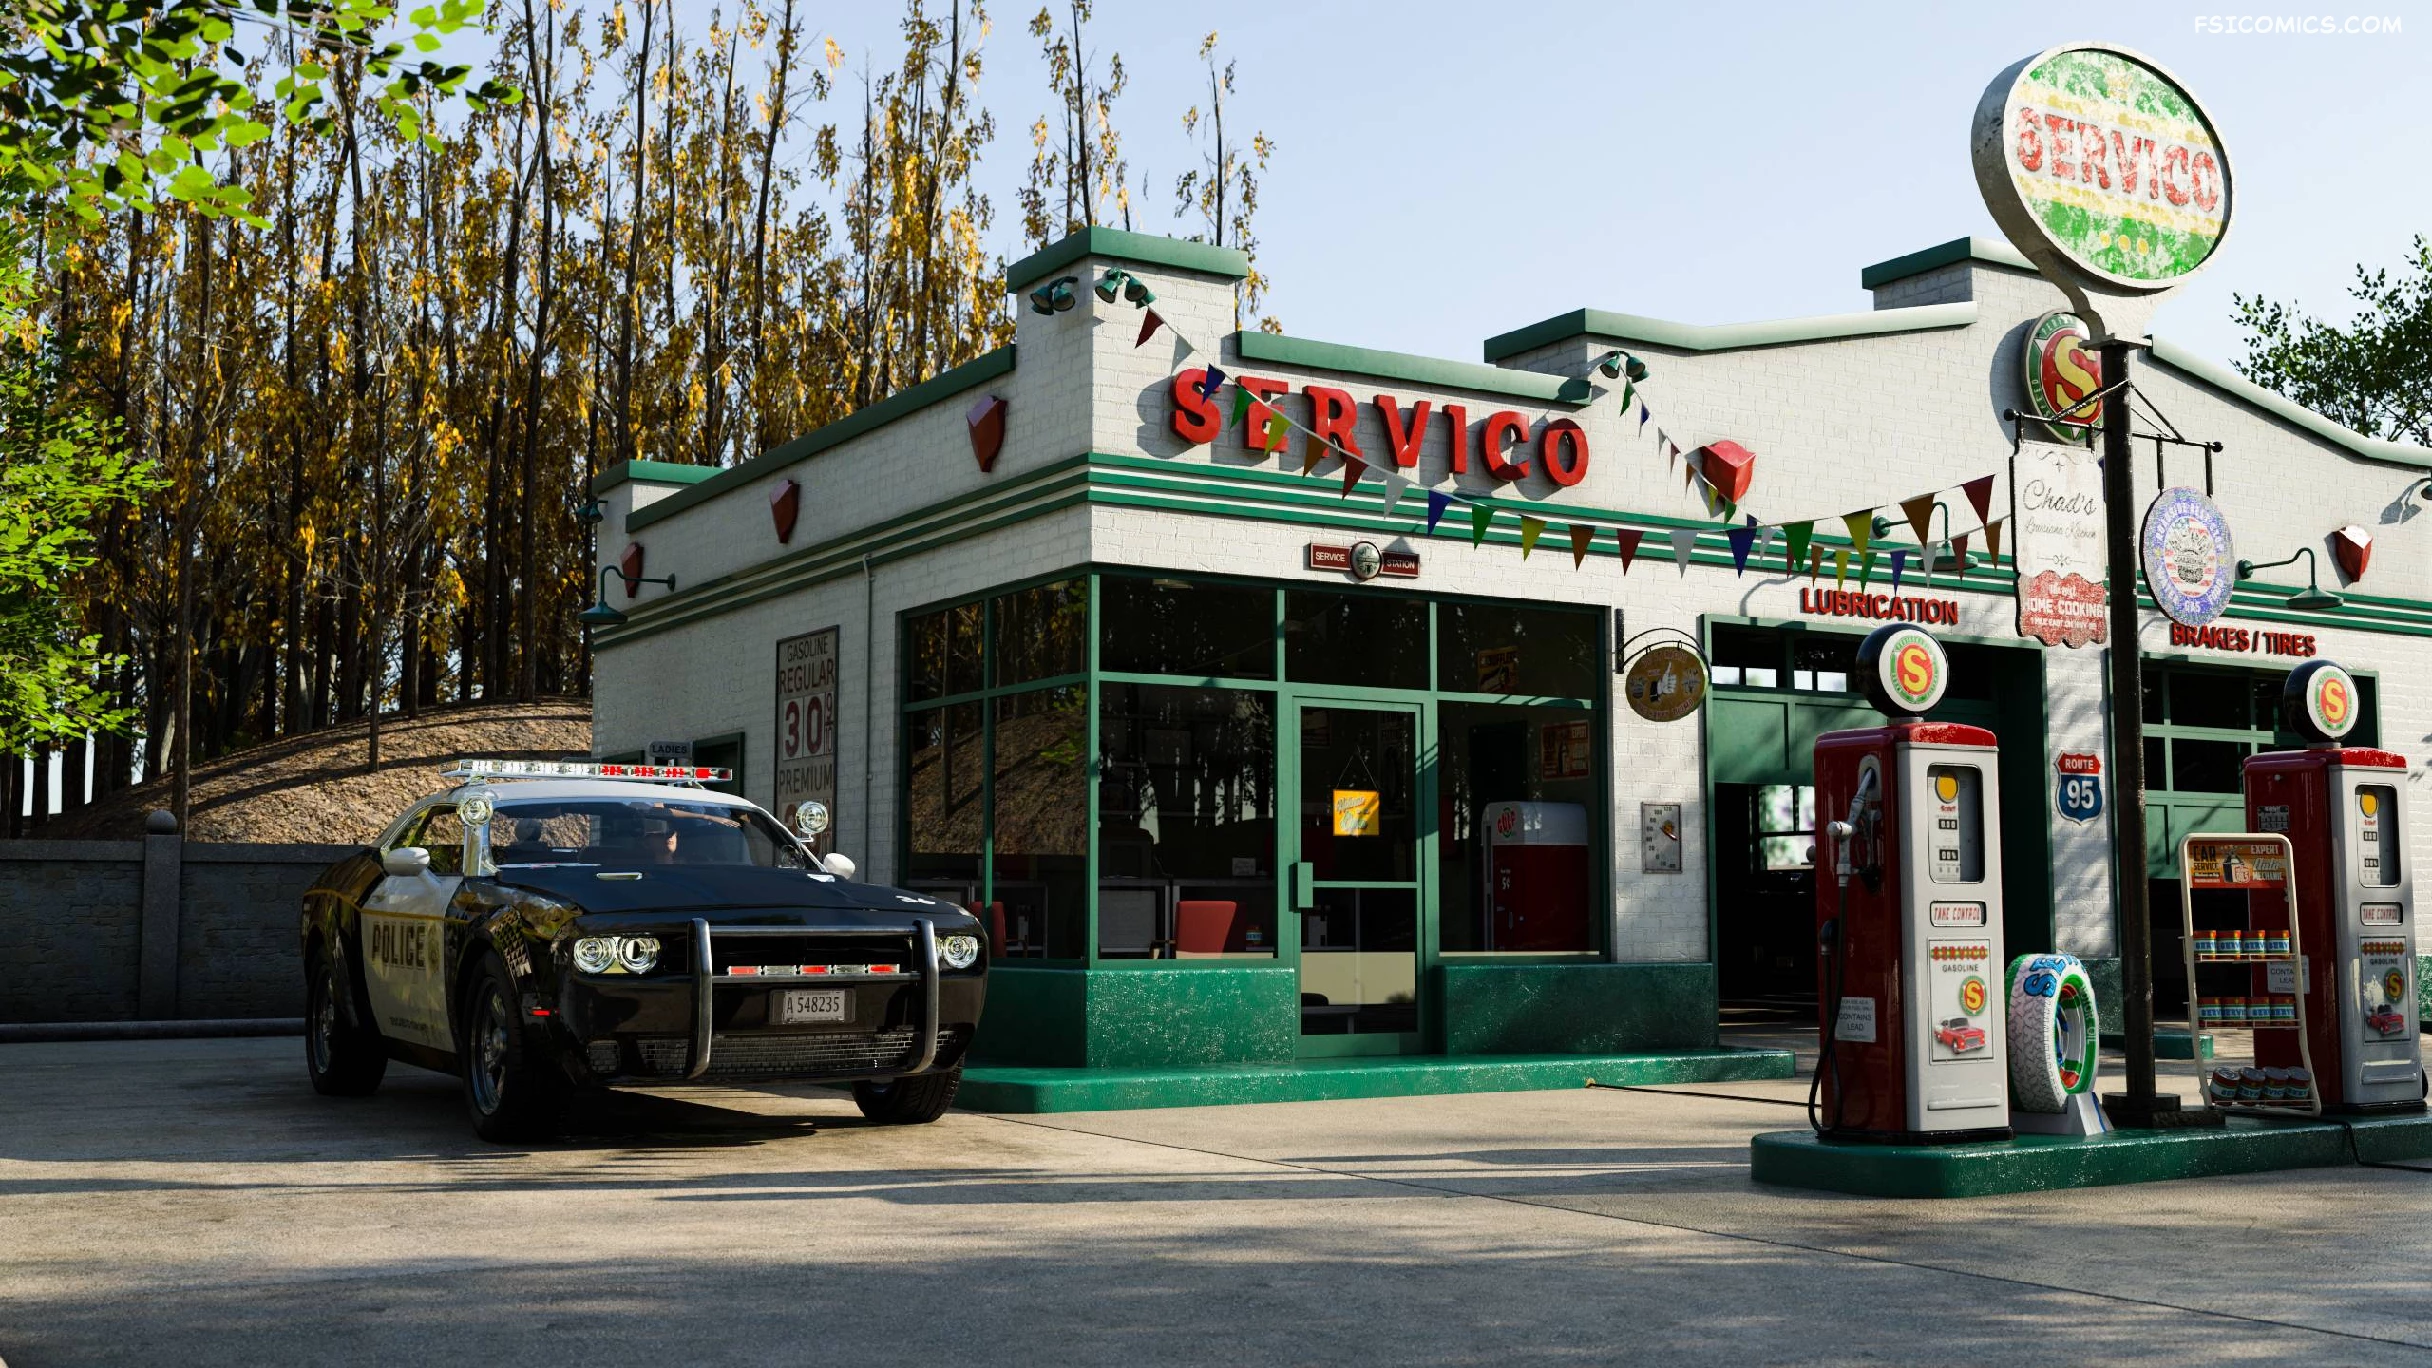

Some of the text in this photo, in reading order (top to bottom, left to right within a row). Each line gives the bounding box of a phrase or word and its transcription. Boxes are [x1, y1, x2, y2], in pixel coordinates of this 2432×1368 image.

[2017, 106, 2219, 213] SERVICO
[2054, 335, 2098, 419] S
[1170, 368, 1590, 487] SERVICO
[2023, 479, 2097, 515] Chad's
[1315, 551, 1415, 569] SERVICE STATION
[1801, 587, 1958, 625] LUBRICATION
[2057, 599, 2103, 618] COOKING
[787, 635, 829, 663] GASOLINE
[2171, 622, 2250, 652] BRAKES
[2264, 631, 2317, 657] TIRES
[779, 658, 835, 695] REGULAR
[1903, 648, 1928, 692] S
[2325, 682, 2344, 720] S
[784, 695, 823, 759] 30
[652, 744, 687, 753] LADIES
[2065, 758, 2094, 770] ROUTE
[779, 762, 833, 798] PREMIUM
[2066, 780, 2095, 809] 95
[2193, 845, 2217, 862] CAR
[2250, 845, 2279, 855] EXPERT
[2193, 862, 2219, 870] SERVICE
[1952, 907, 1981, 921] CONTROL
[372, 923, 426, 969] POLICE
[1942, 964, 1979, 973] GASOLINE
[2270, 968, 2307, 976] CONTAS
[2369, 958, 2398, 966] GASOLINE
[787, 996, 840, 1014] A 548235
[1966, 982, 1981, 1010] S
[1839, 1012, 1872, 1021] CONTAINS
[1847, 1023, 1864, 1031] LEAD
